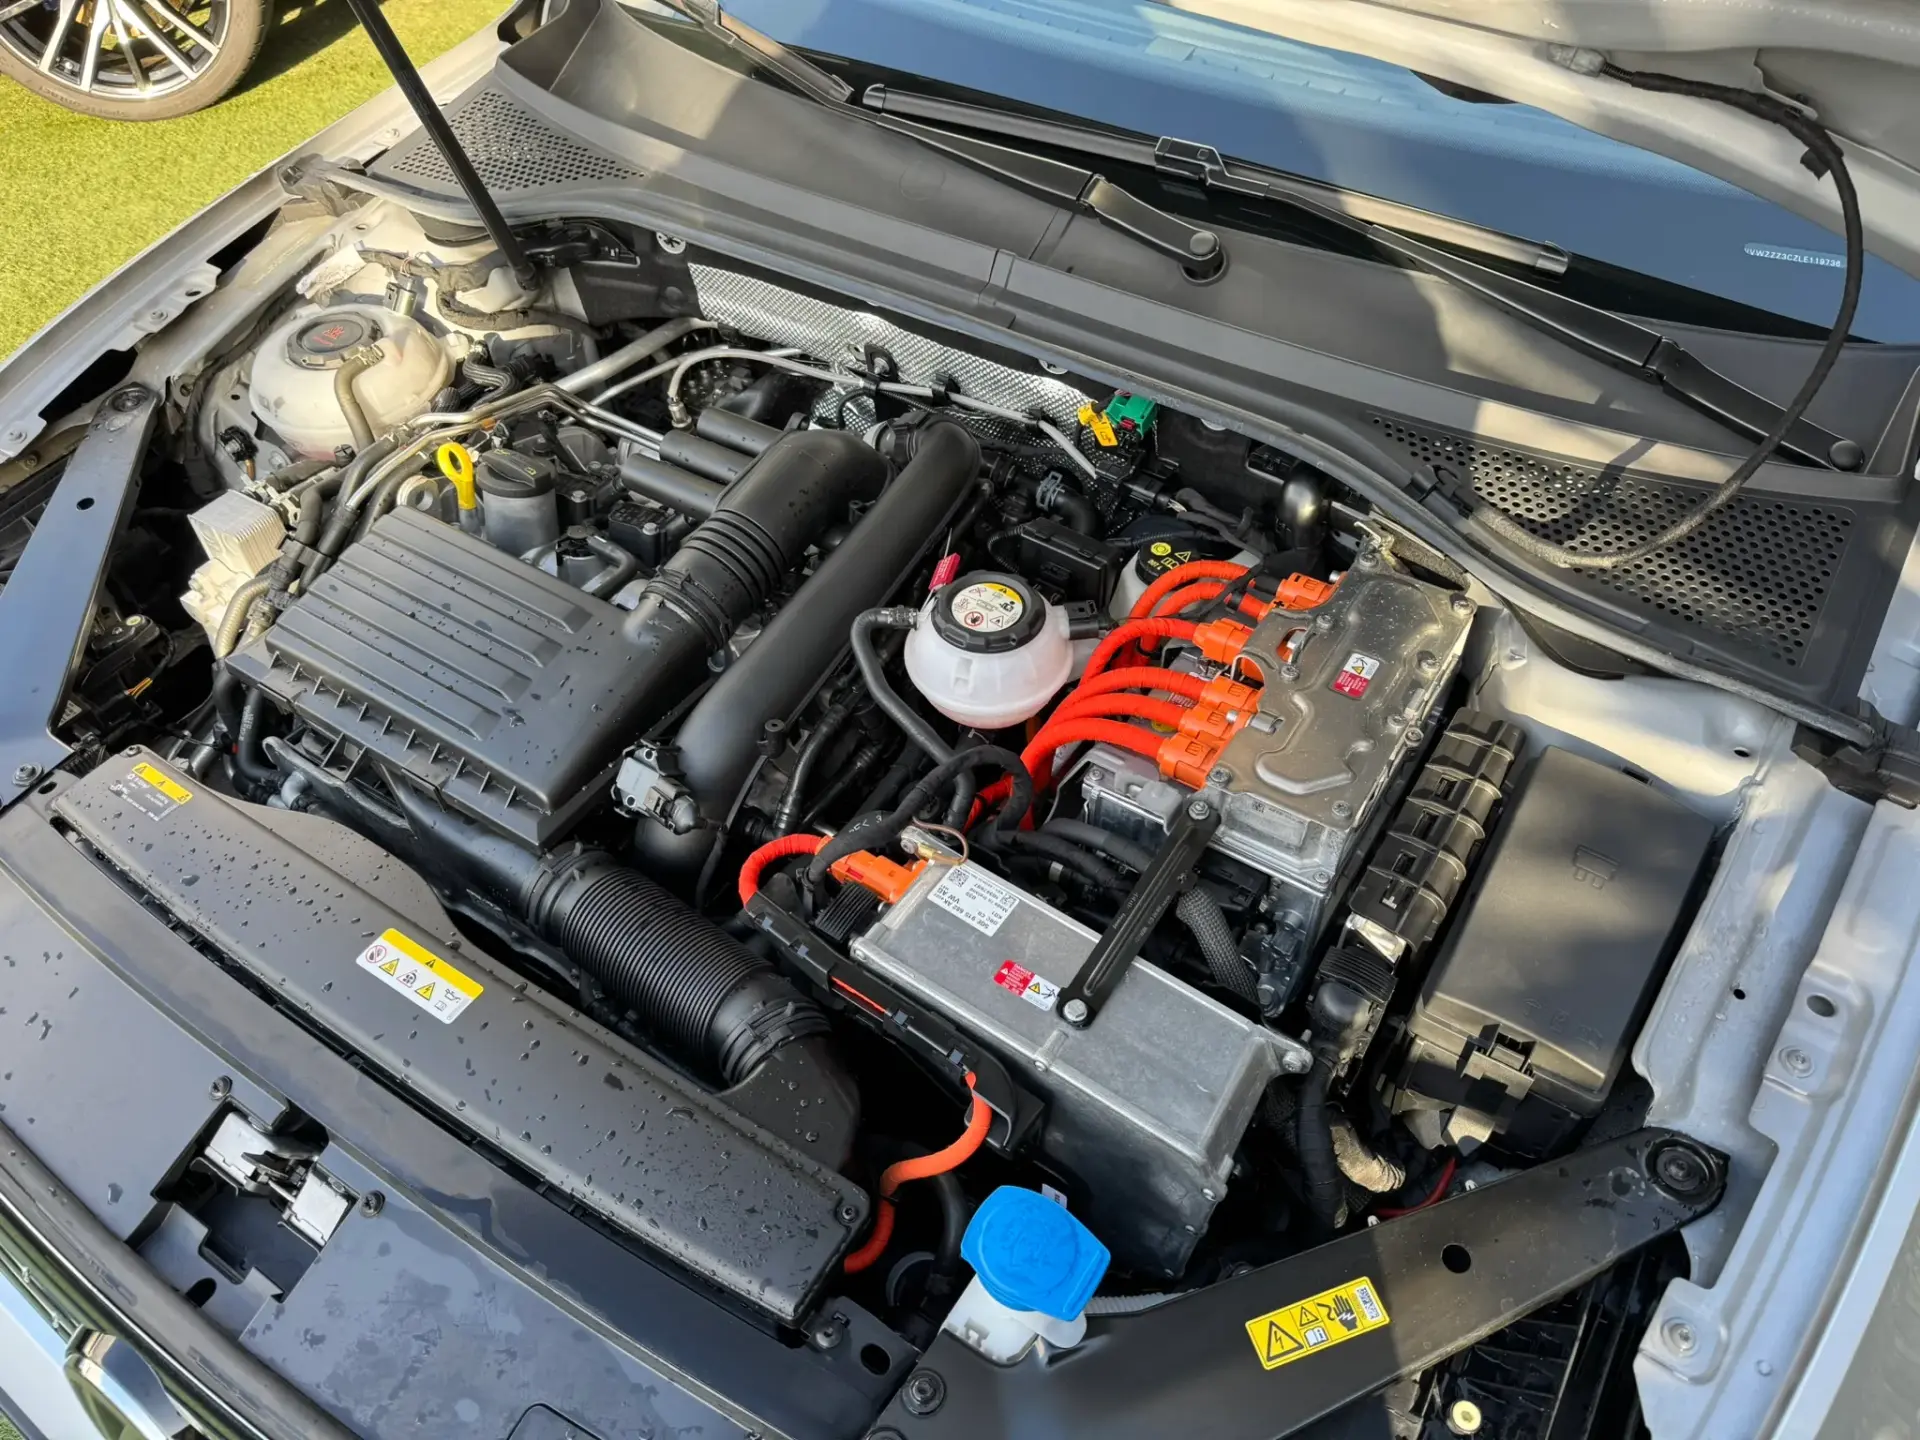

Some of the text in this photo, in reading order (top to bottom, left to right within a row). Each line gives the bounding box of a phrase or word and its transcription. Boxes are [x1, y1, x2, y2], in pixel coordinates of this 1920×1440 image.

[936, 886, 948, 896] AG
[968, 886, 987, 900] Ireland
[947, 893, 960, 904] VW
[993, 901, 1008, 913] Made
